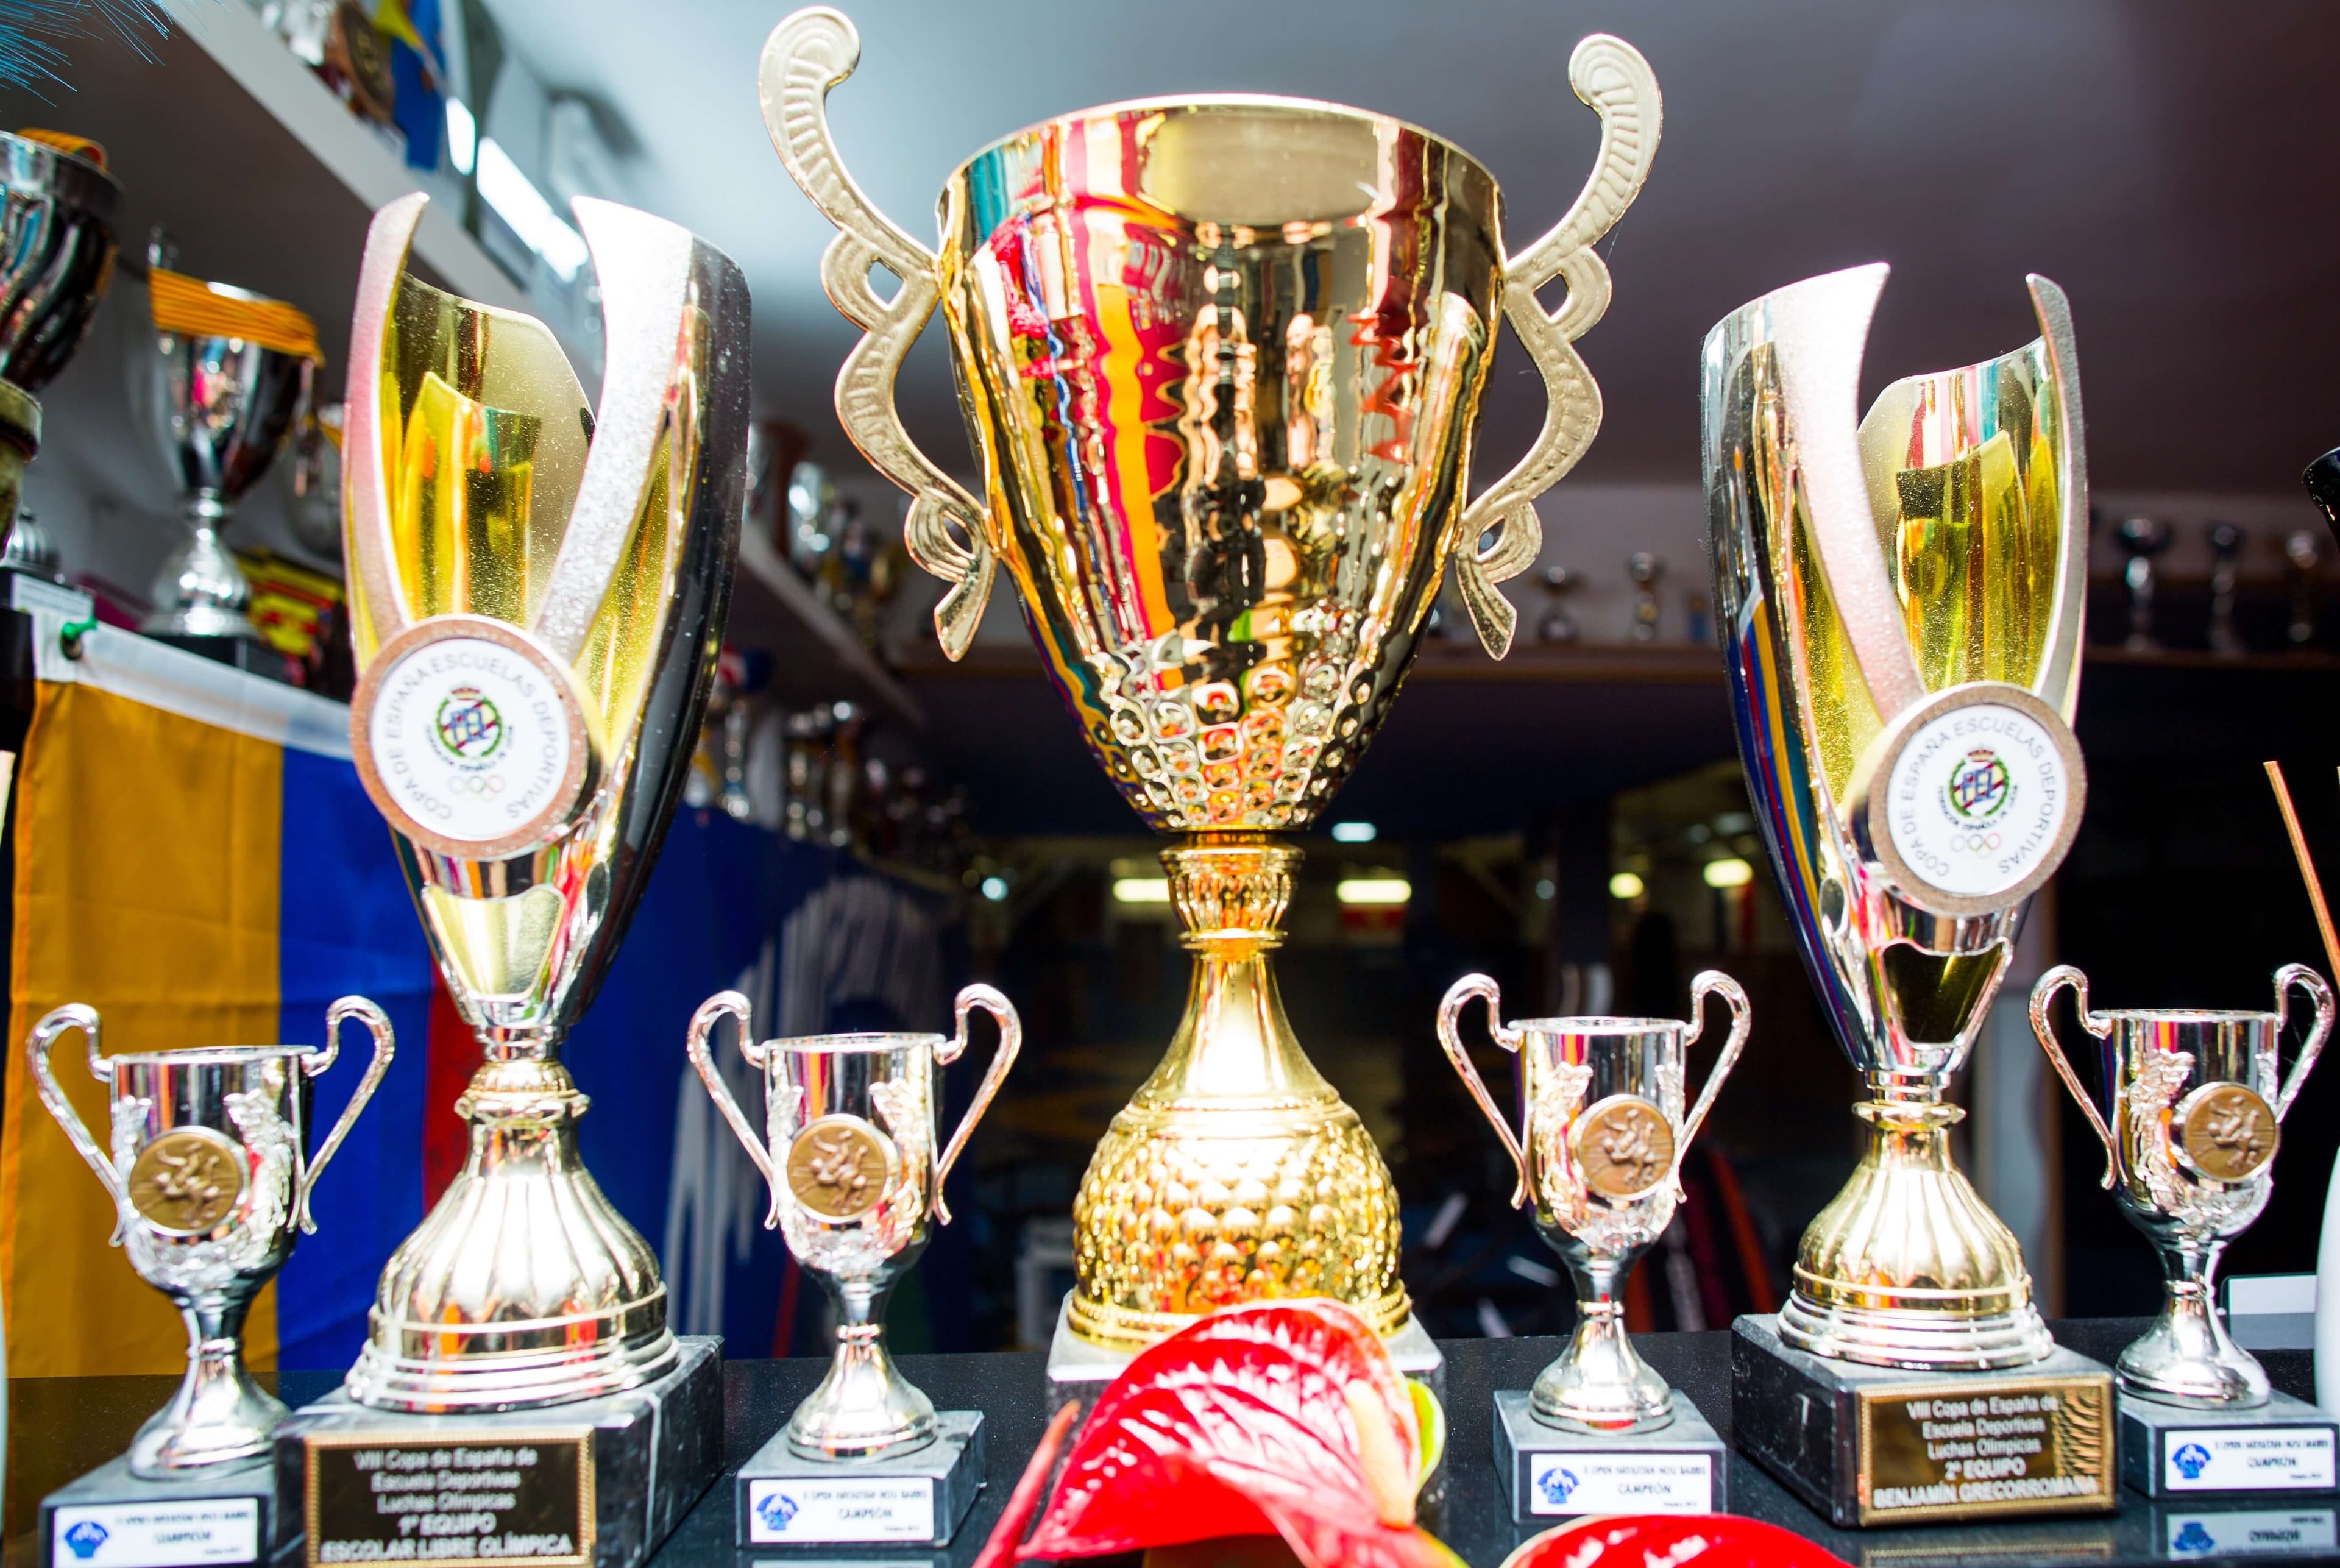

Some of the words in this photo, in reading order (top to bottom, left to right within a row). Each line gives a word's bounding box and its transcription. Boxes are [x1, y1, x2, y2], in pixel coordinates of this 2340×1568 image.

[431, 653, 536, 697] ESCUELAS
[1953, 716, 2044, 759] ESCUELAS
[388, 749, 408, 774] DE
[506, 701, 557, 818] DEPORTIVAS
[1901, 731, 1950, 800] ESPAÑA
[405, 778, 452, 820] COPA
[1901, 809, 1917, 834] DE
[1998, 762, 2057, 874] DEPORTIVAS
[1910, 839, 1949, 876] COPA
[1906, 1400, 1931, 1421] VIII
[1932, 1399, 1969, 1421] Copa
[1970, 1397, 1988, 1416] de
[1989, 1395, 2040, 1417] España
[1976, 1416, 2046, 1439] Deportivas
[385, 1449, 429, 1472] Copa
[430, 1448, 452, 1469] de
[453, 1447, 514, 1470] España
[515, 1446, 538, 1466] de
[1927, 1440, 1976, 1460] Luchas
[1963, 1456, 2027, 1480] EQUIPO
[419, 1511, 497, 1536] EQUIPO
[321, 1539, 416, 1563] ESCOLAR
[417, 1536, 478, 1560] LIBRE
